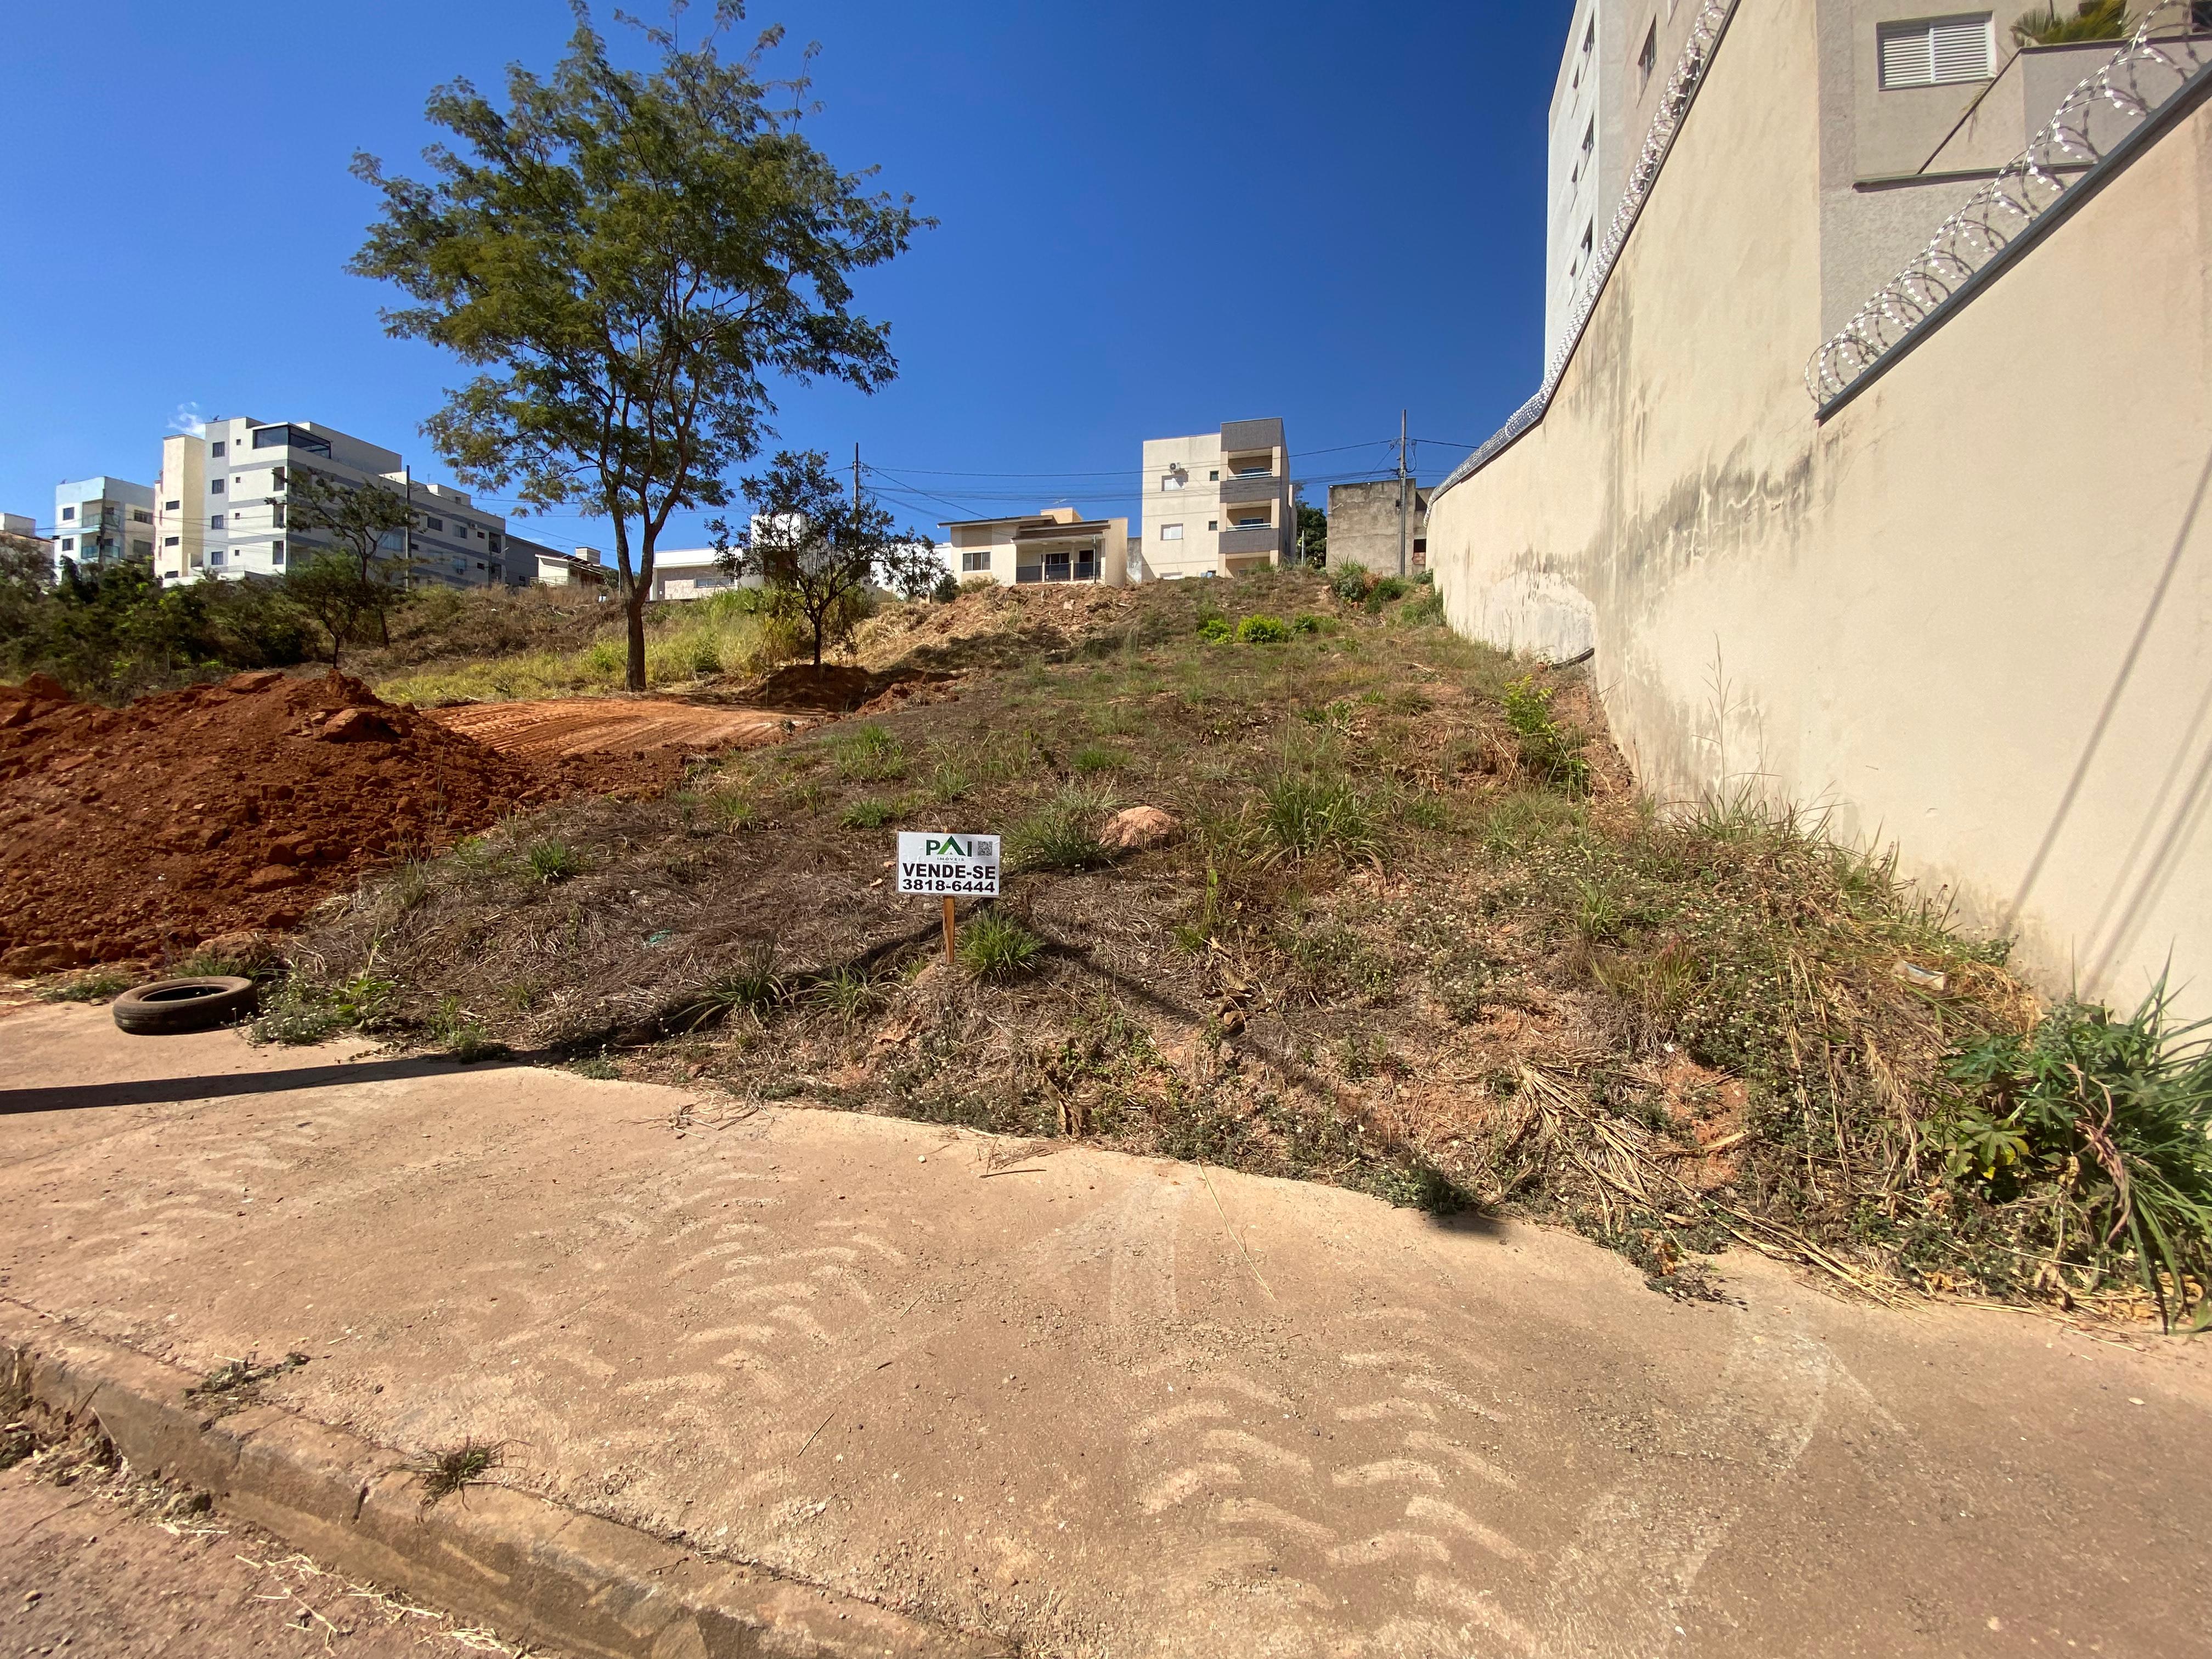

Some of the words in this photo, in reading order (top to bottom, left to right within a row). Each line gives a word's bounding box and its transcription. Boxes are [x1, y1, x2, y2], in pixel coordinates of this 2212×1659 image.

[926, 836, 972, 857] PAI
[902, 863, 996, 879] VENDE-SE
[902, 879, 995, 893] 3818-6444
